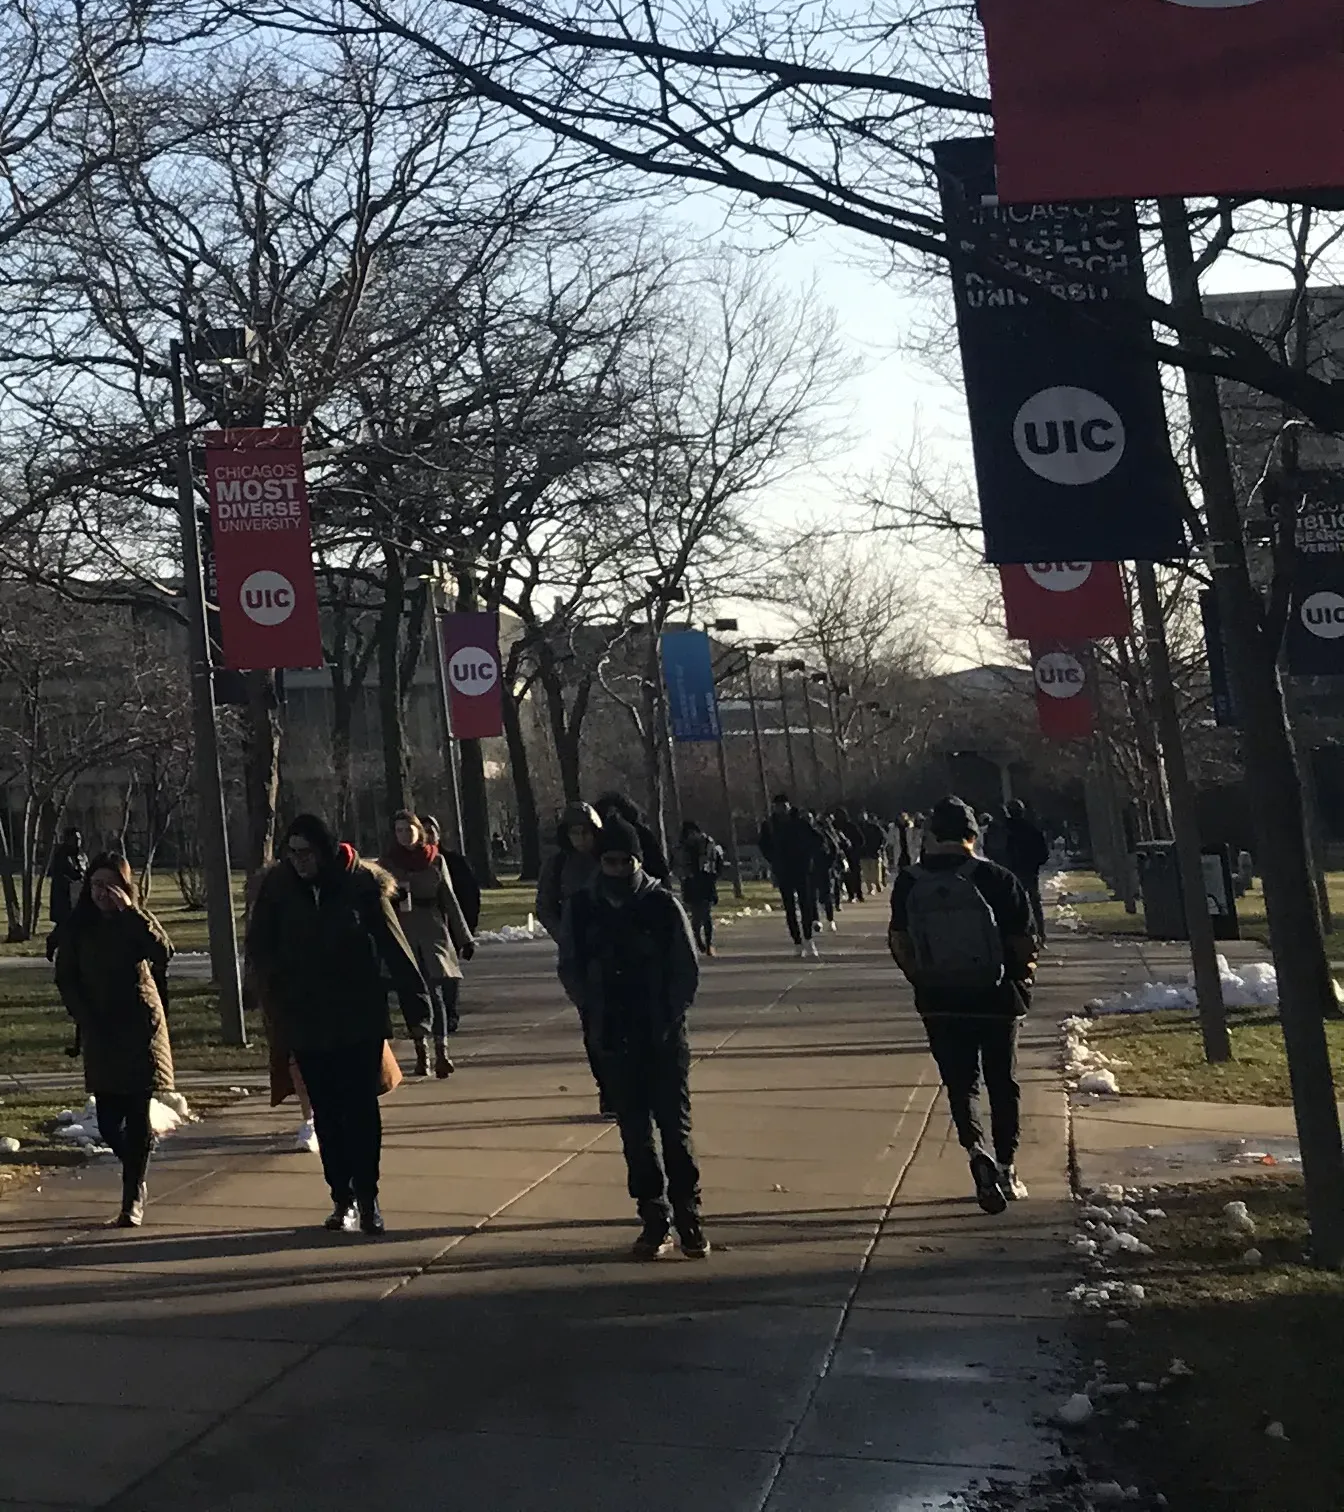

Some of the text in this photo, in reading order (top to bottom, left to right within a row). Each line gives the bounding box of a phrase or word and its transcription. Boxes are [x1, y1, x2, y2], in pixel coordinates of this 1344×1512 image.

[1023, 418, 1116, 455] UIC
[215, 478, 299, 503] MOST
[217, 501, 301, 519] DIVERSE
[219, 517, 302, 533] UNIVERSITY
[245, 588, 291, 609] UIC
[453, 662, 493, 682] UIC
